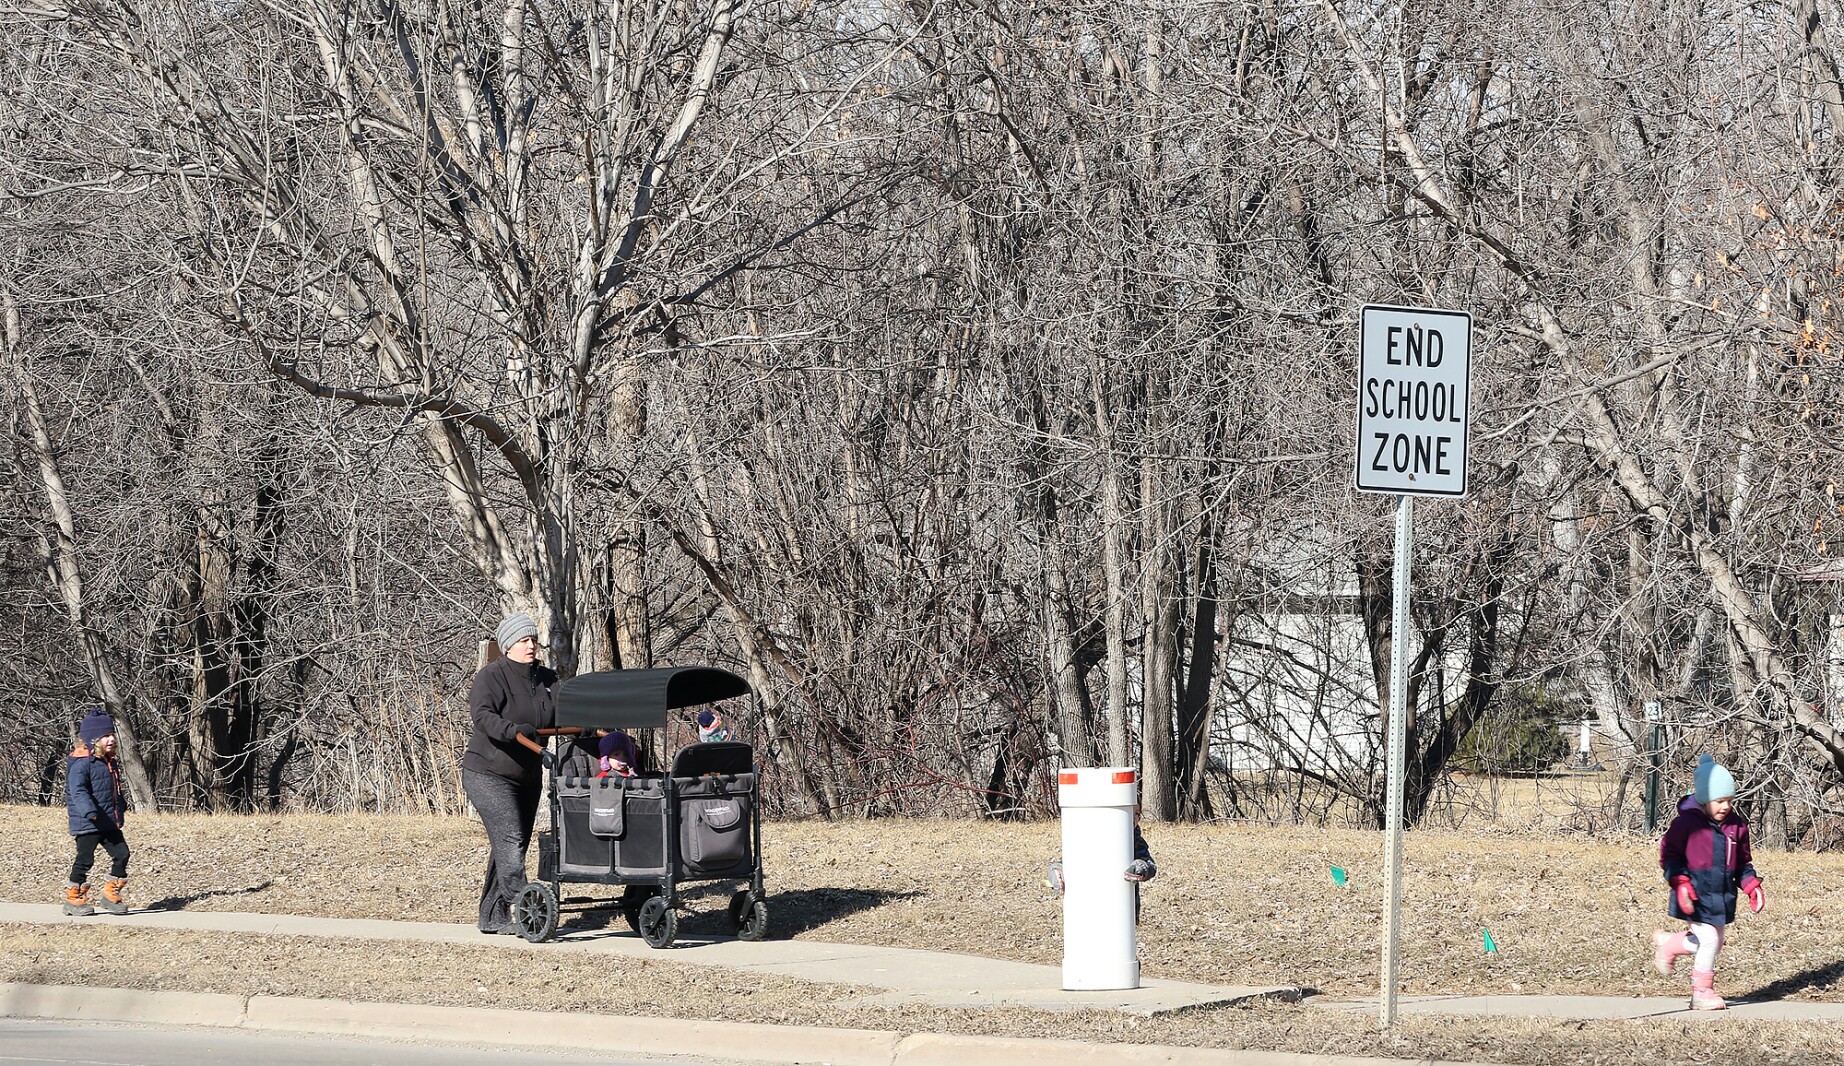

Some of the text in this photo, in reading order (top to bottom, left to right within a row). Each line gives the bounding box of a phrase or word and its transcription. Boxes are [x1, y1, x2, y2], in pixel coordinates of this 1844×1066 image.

[1387, 326, 1444, 367] END
[1366, 377, 1461, 423] SCHOOL
[1372, 432, 1451, 475] ZONE
[1647, 706, 1659, 716] 23
